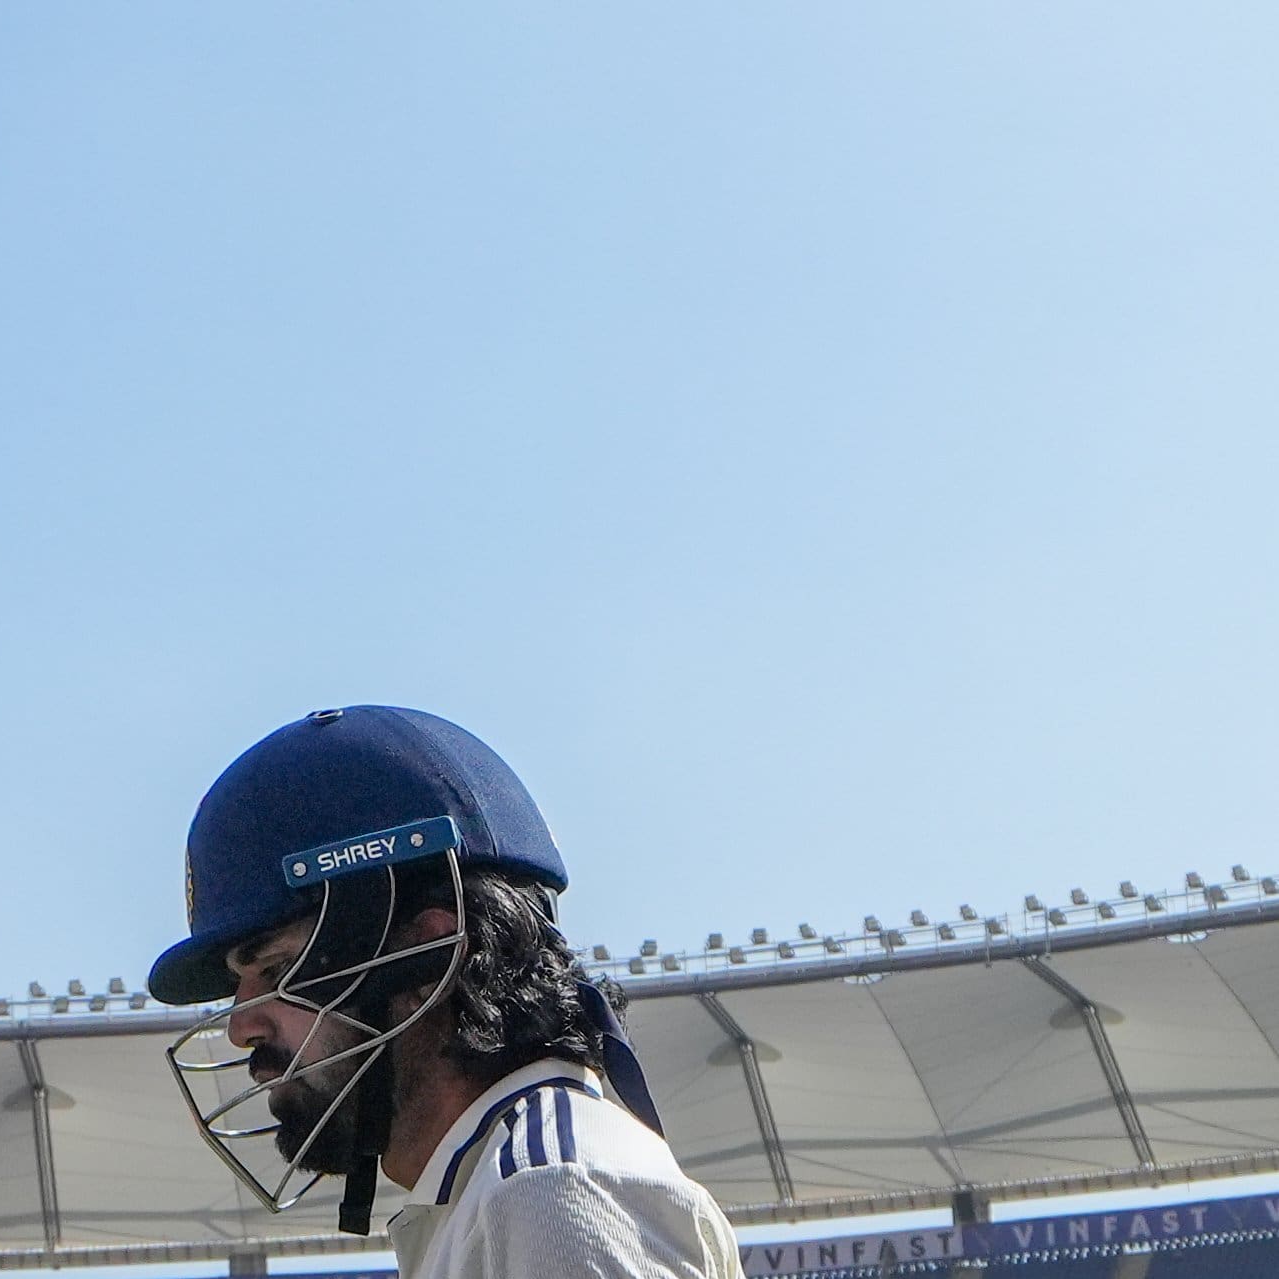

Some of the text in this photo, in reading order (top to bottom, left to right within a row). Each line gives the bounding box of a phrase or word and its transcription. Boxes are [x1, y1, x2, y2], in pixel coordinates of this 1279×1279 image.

[317, 837, 396, 872] SHREY
[1014, 1206, 1208, 1249] VINFAST
[765, 1232, 955, 1270] VINFAST
